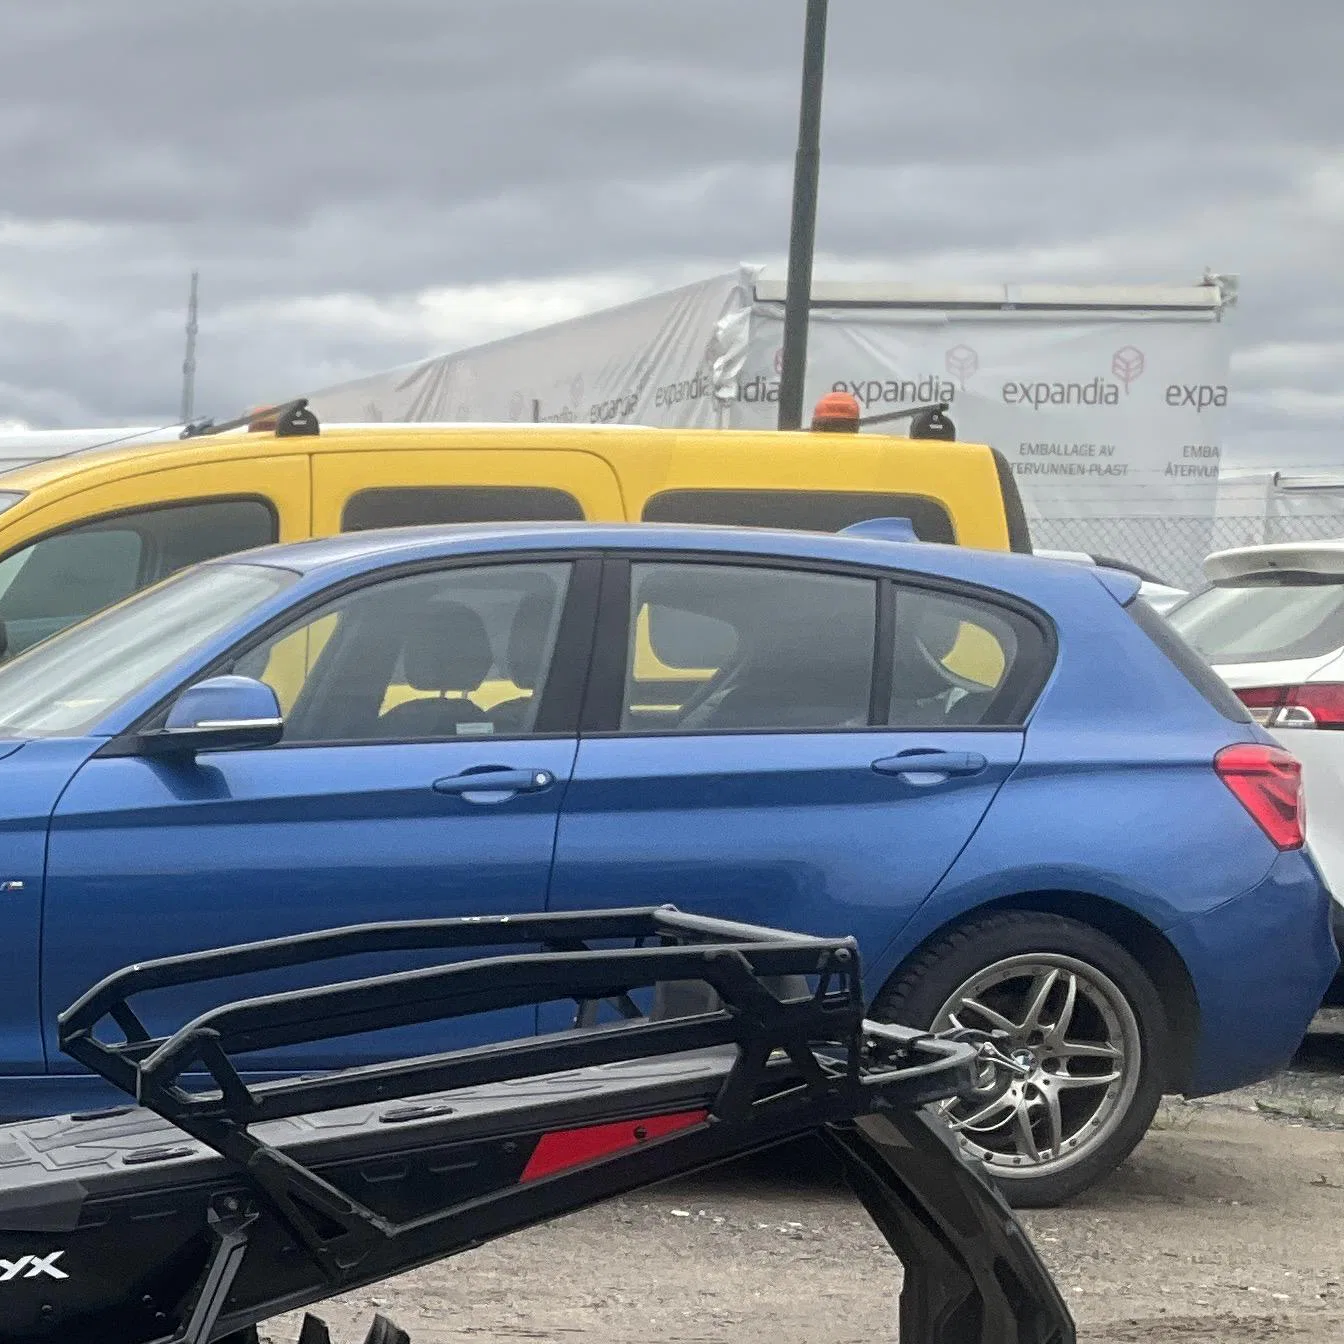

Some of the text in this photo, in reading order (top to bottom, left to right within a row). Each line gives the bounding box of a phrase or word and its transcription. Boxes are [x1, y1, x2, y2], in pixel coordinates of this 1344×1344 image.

[1002, 376, 1120, 410] expandia
[1019, 442, 1116, 458] EMBALLAGE AV
[1009, 461, 1129, 477] TERVUNNEN PLAST
